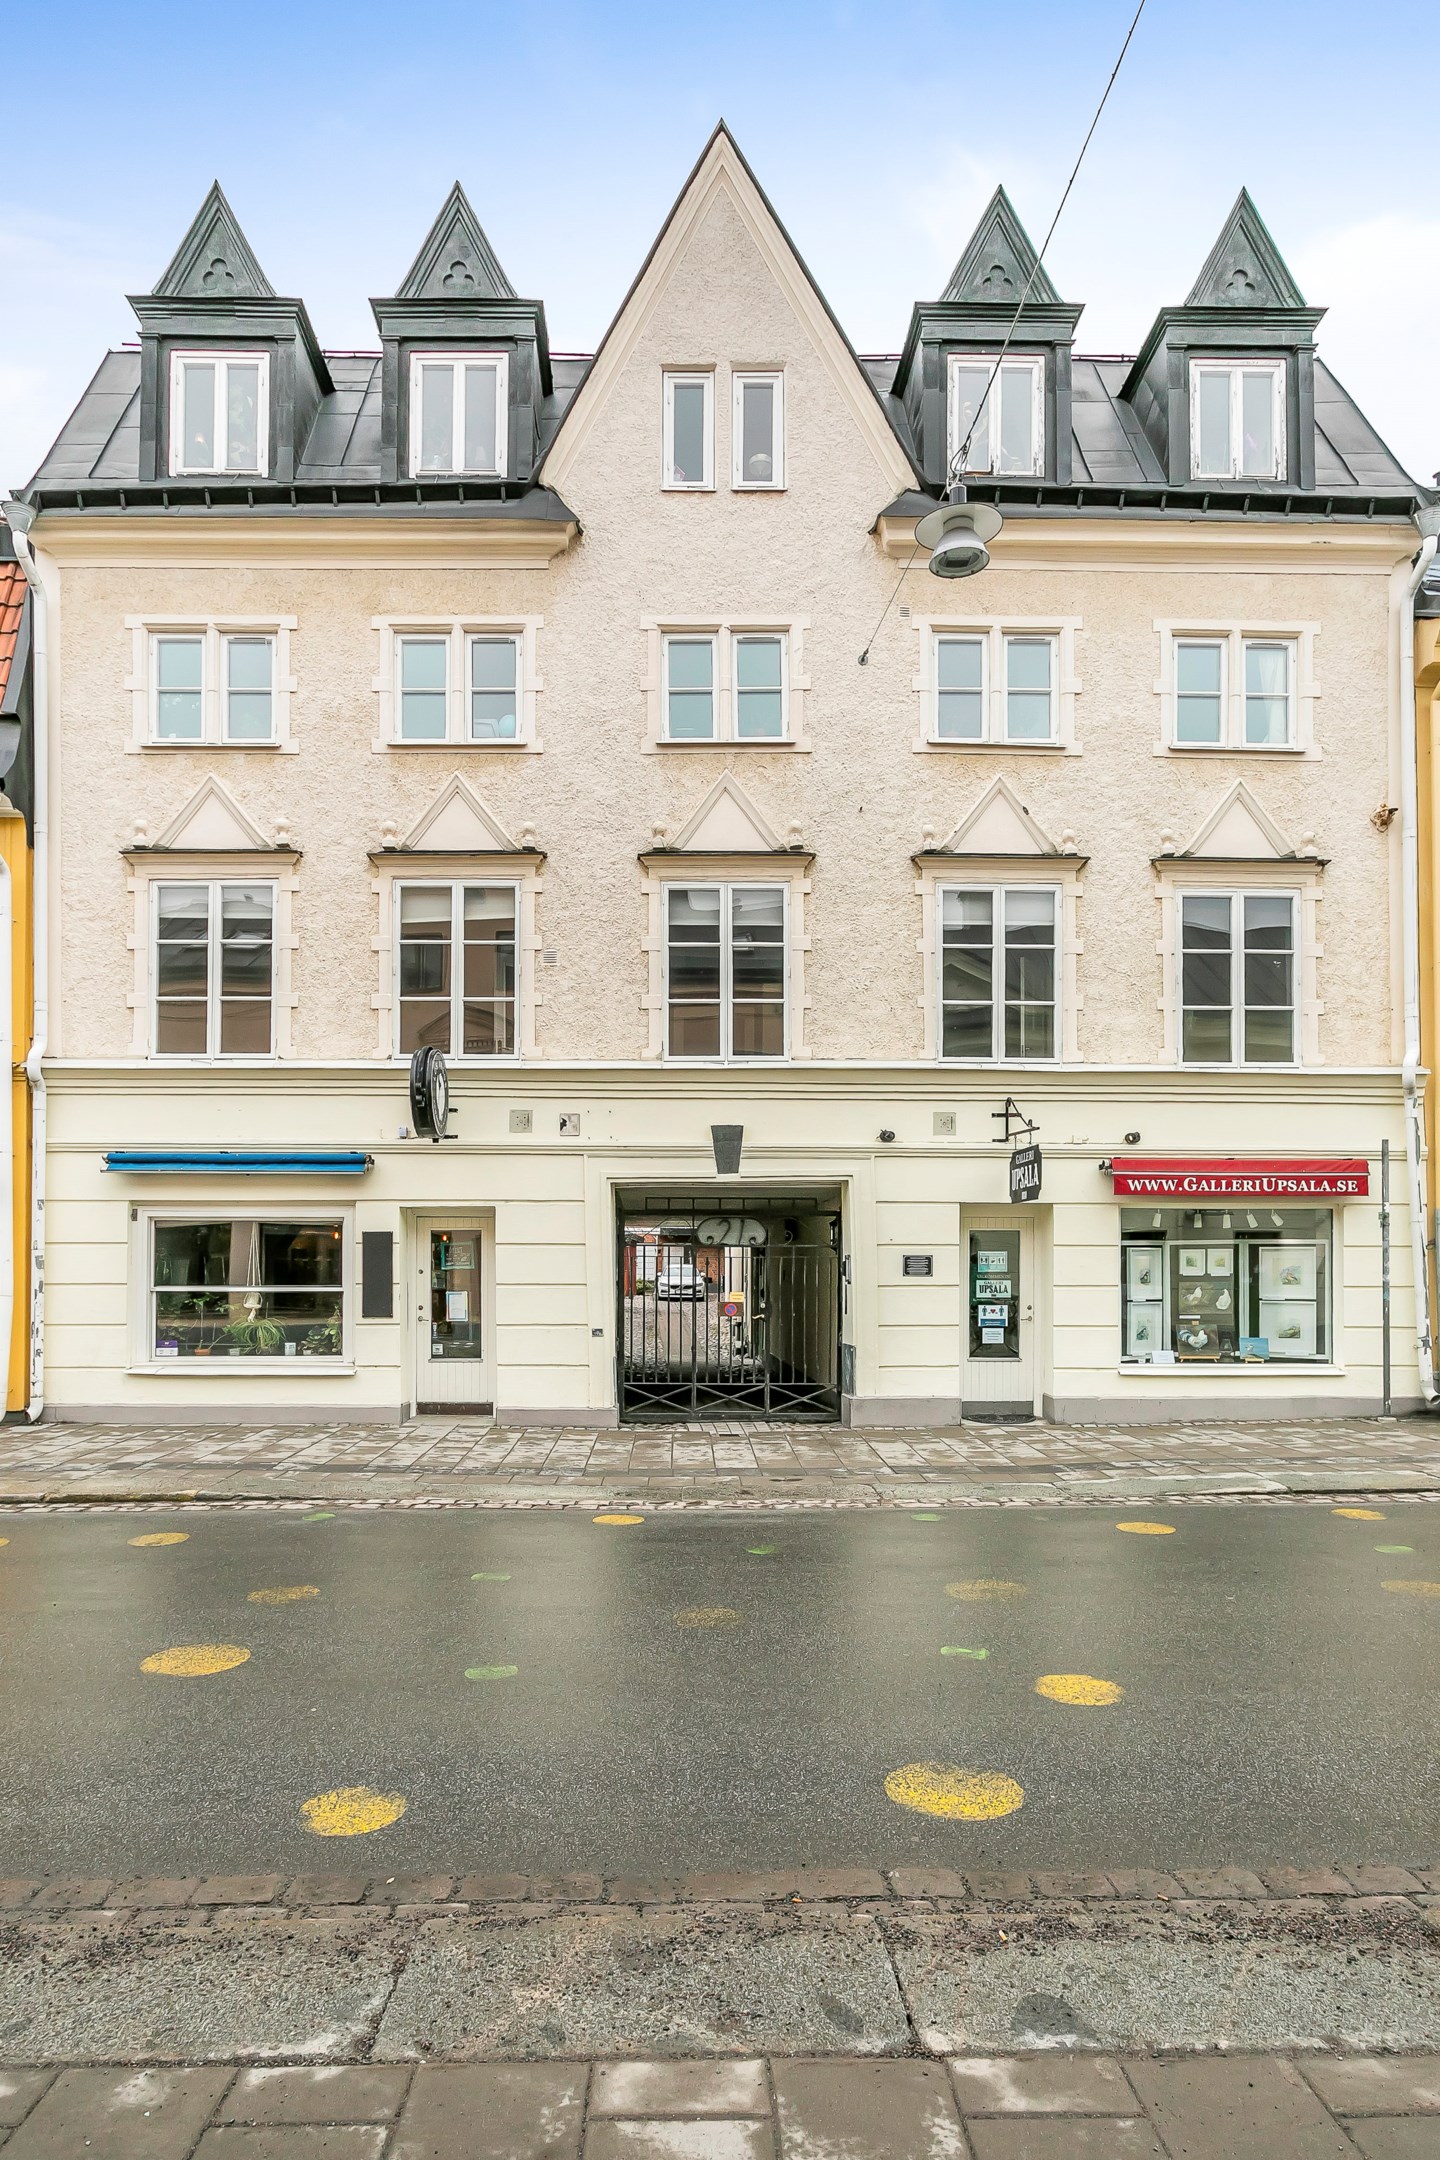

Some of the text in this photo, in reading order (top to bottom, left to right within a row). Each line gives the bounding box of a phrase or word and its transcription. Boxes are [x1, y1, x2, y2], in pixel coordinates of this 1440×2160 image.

[1012, 1163, 1039, 1190] UPSALA
[1127, 1177, 1358, 1192] WWW.GALLERIUPSALA.SE
[979, 1284, 1009, 1294] UPSALA
